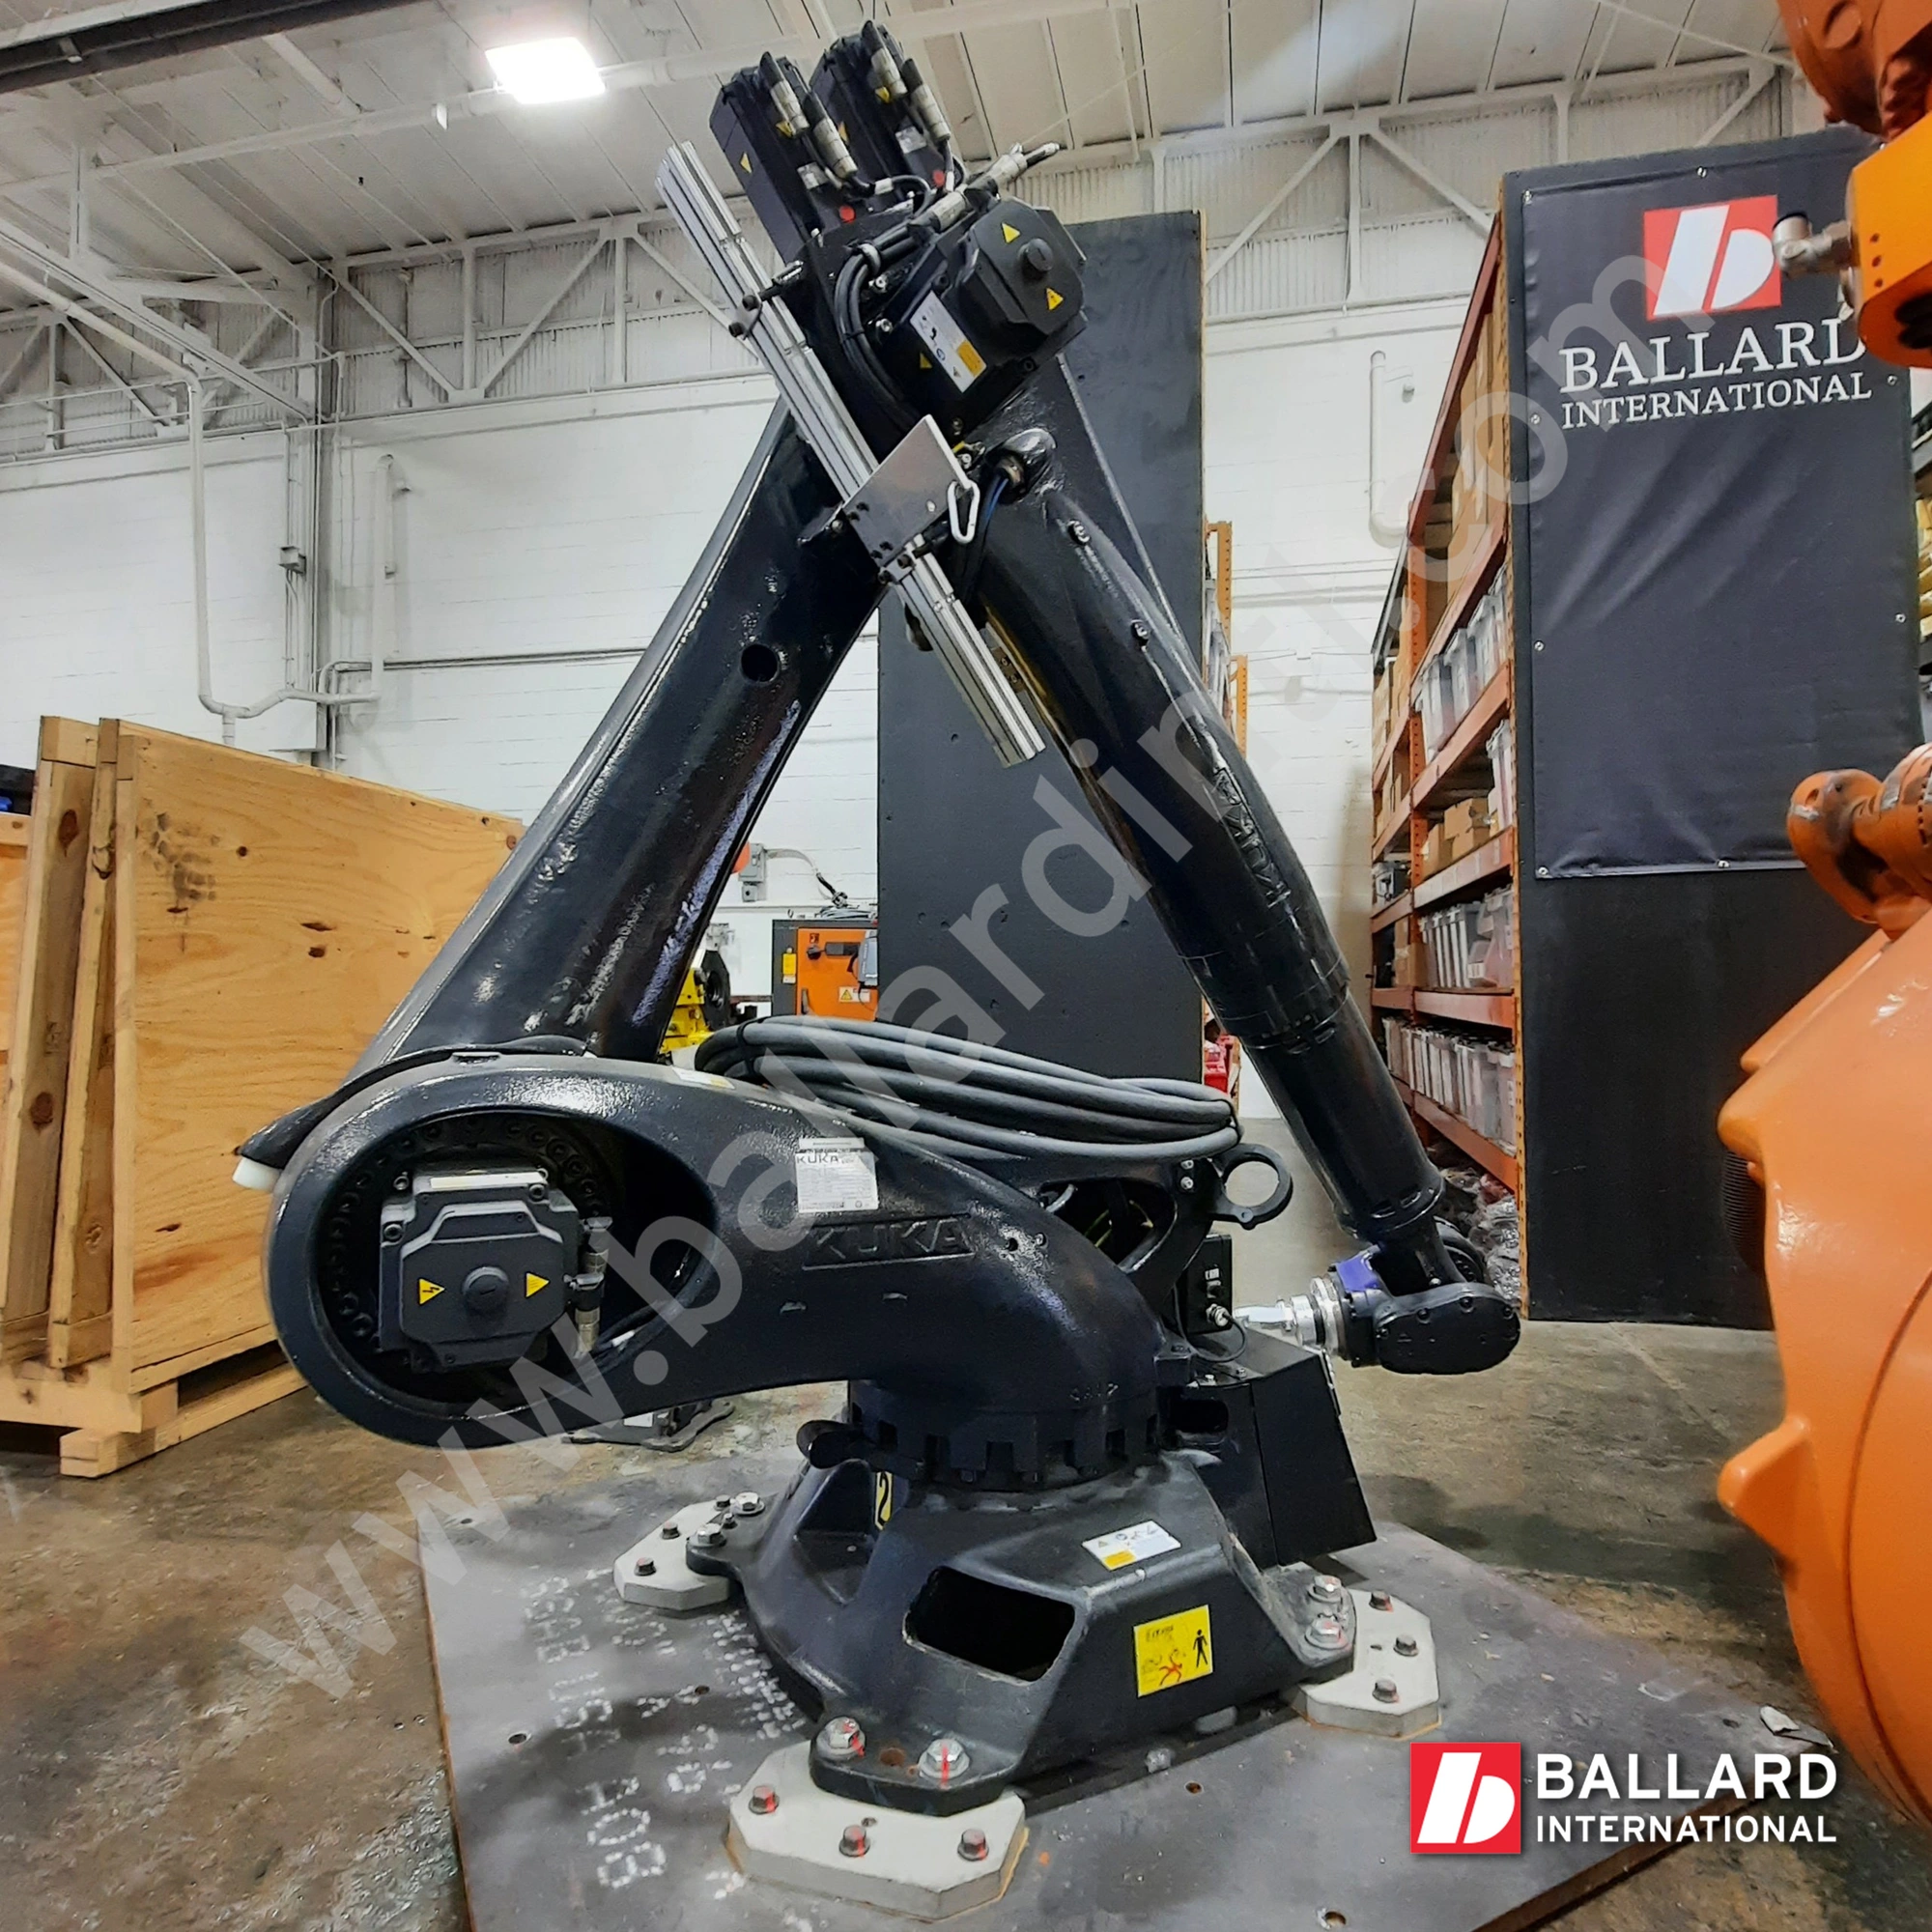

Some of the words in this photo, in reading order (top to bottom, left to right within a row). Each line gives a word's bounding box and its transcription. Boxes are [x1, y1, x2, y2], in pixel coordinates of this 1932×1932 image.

[1558, 318, 1867, 394] BALLARD
[1561, 372, 1873, 431] INTERNATIONAL
[797, 1153, 839, 1165] KUKA
[810, 1218, 976, 1260] KUKA
